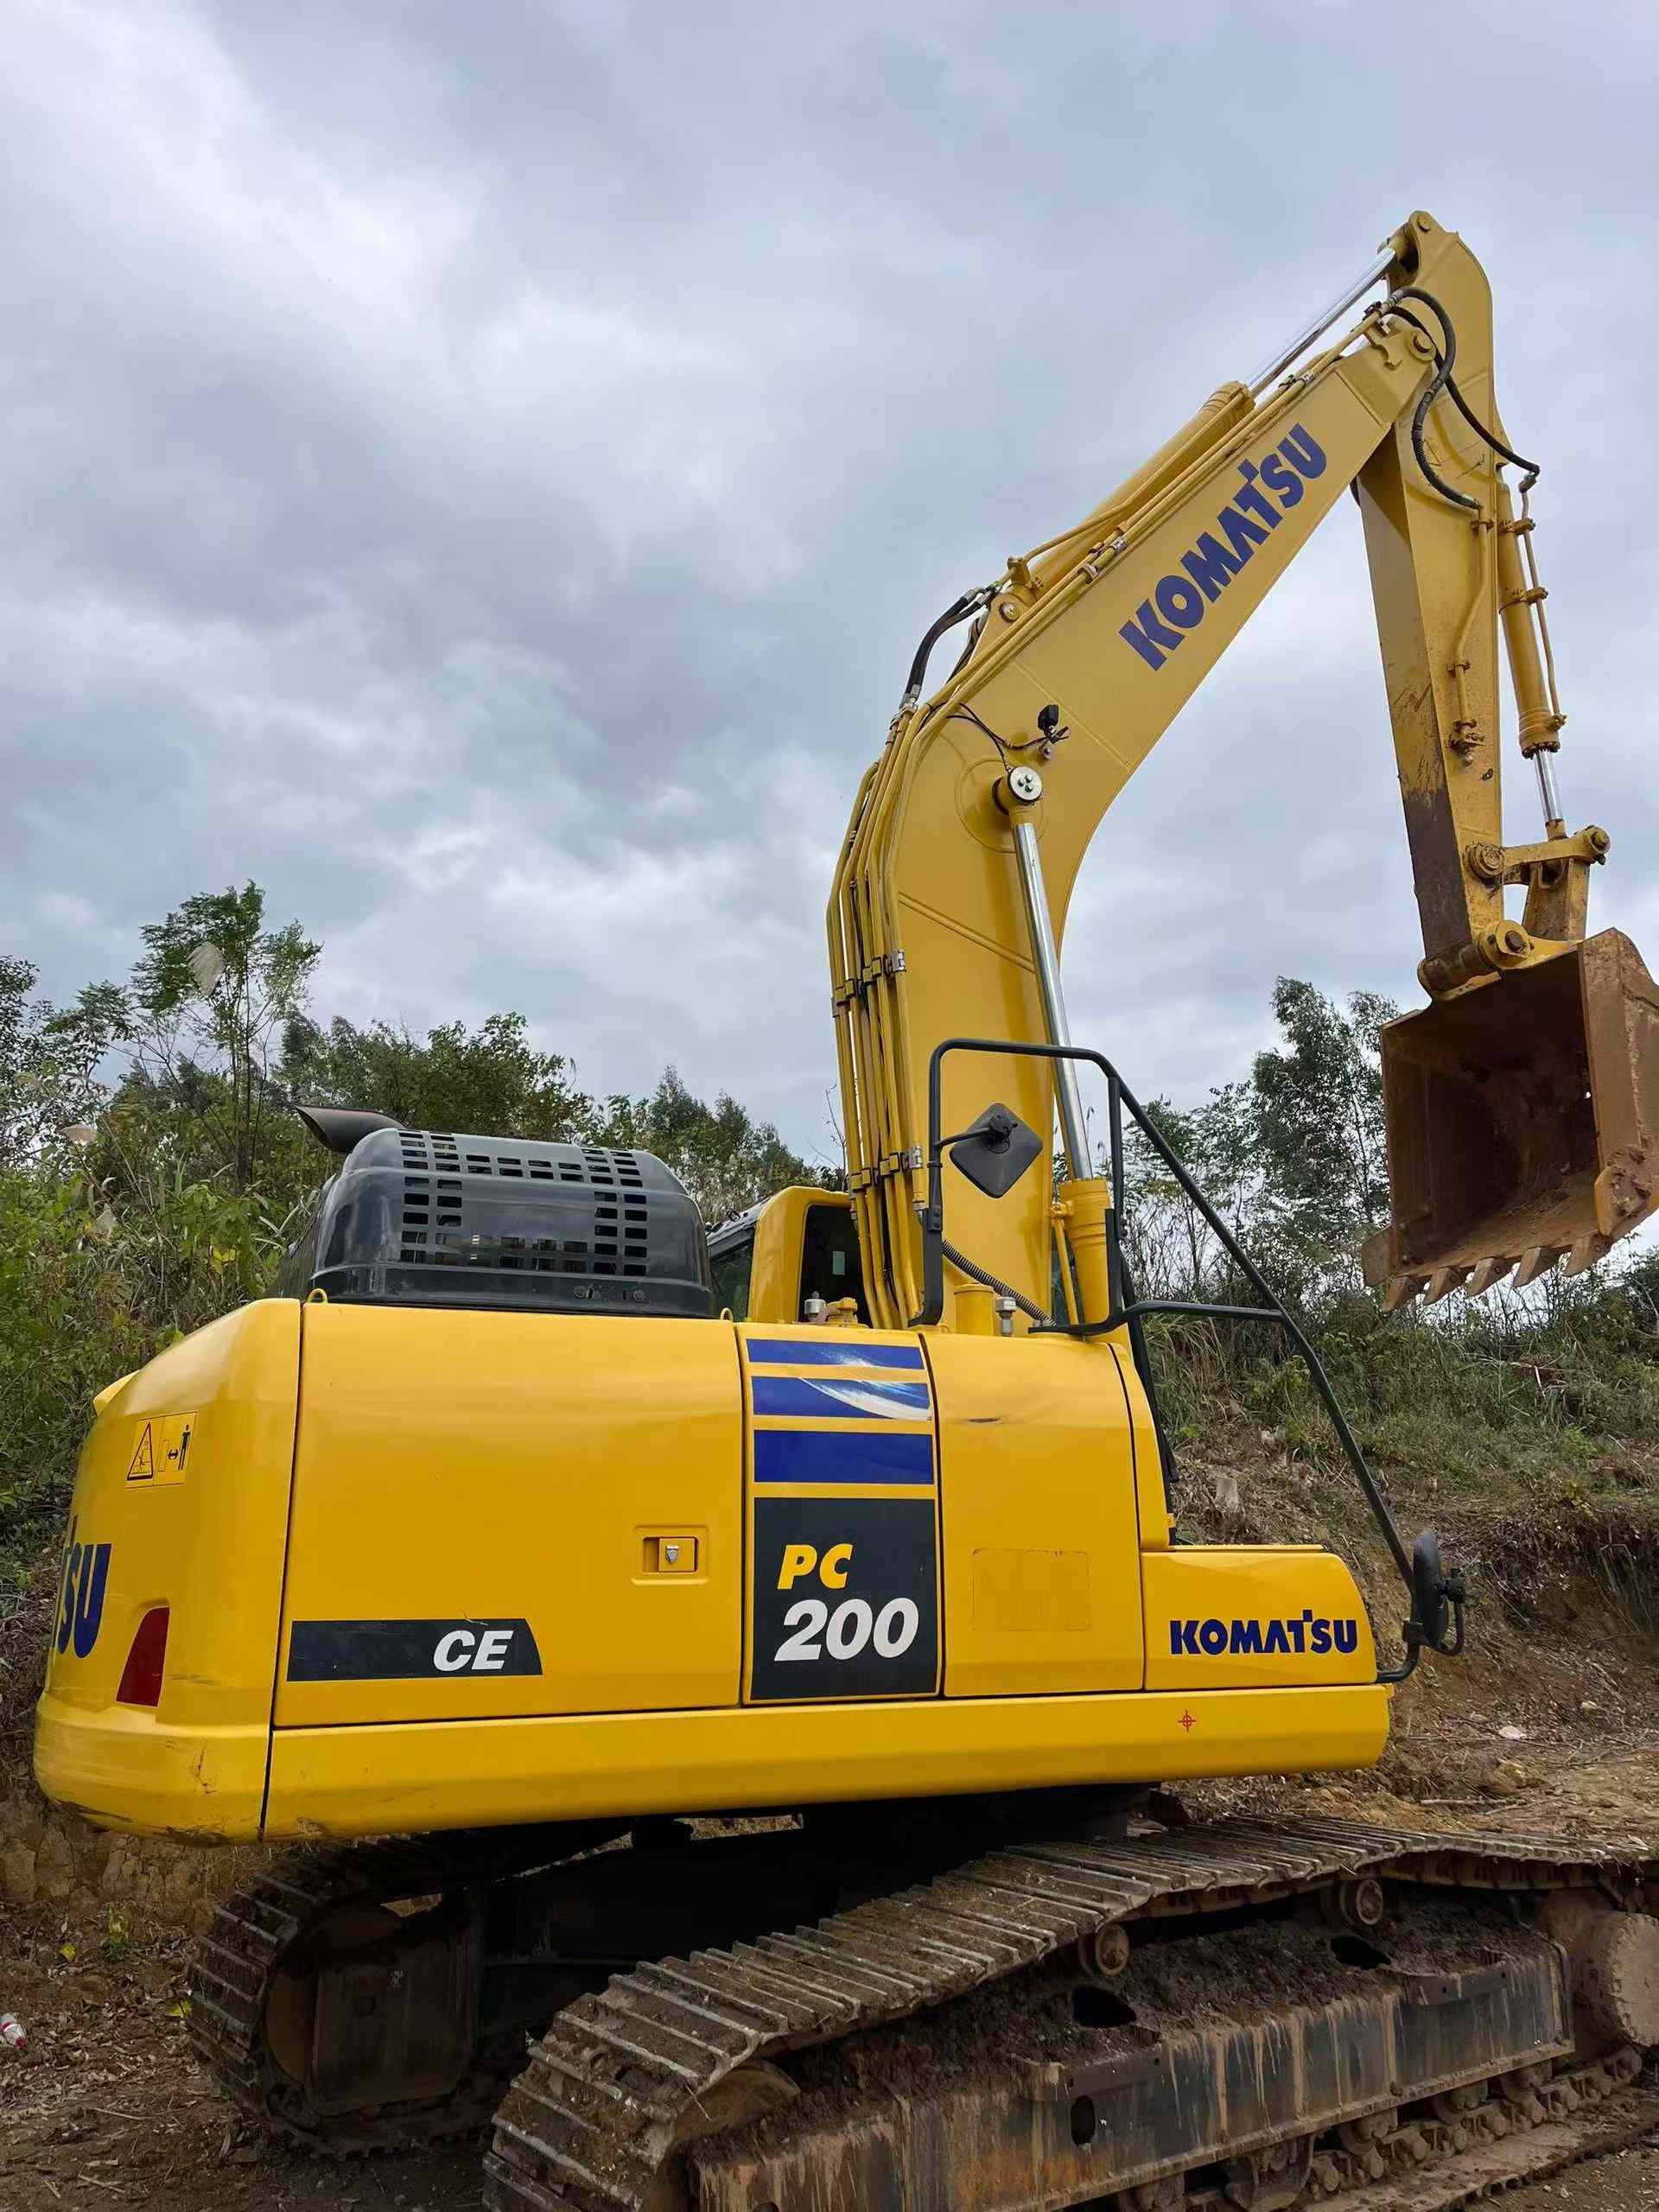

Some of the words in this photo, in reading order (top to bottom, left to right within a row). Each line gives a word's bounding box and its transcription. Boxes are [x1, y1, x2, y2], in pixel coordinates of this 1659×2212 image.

[1118, 423, 1327, 671] KOMATSU
[777, 1543, 854, 1590] PC
[433, 1630, 514, 1672] CE
[774, 1598, 919, 1662] 200
[1170, 1610, 1358, 1656] KOMATSU
